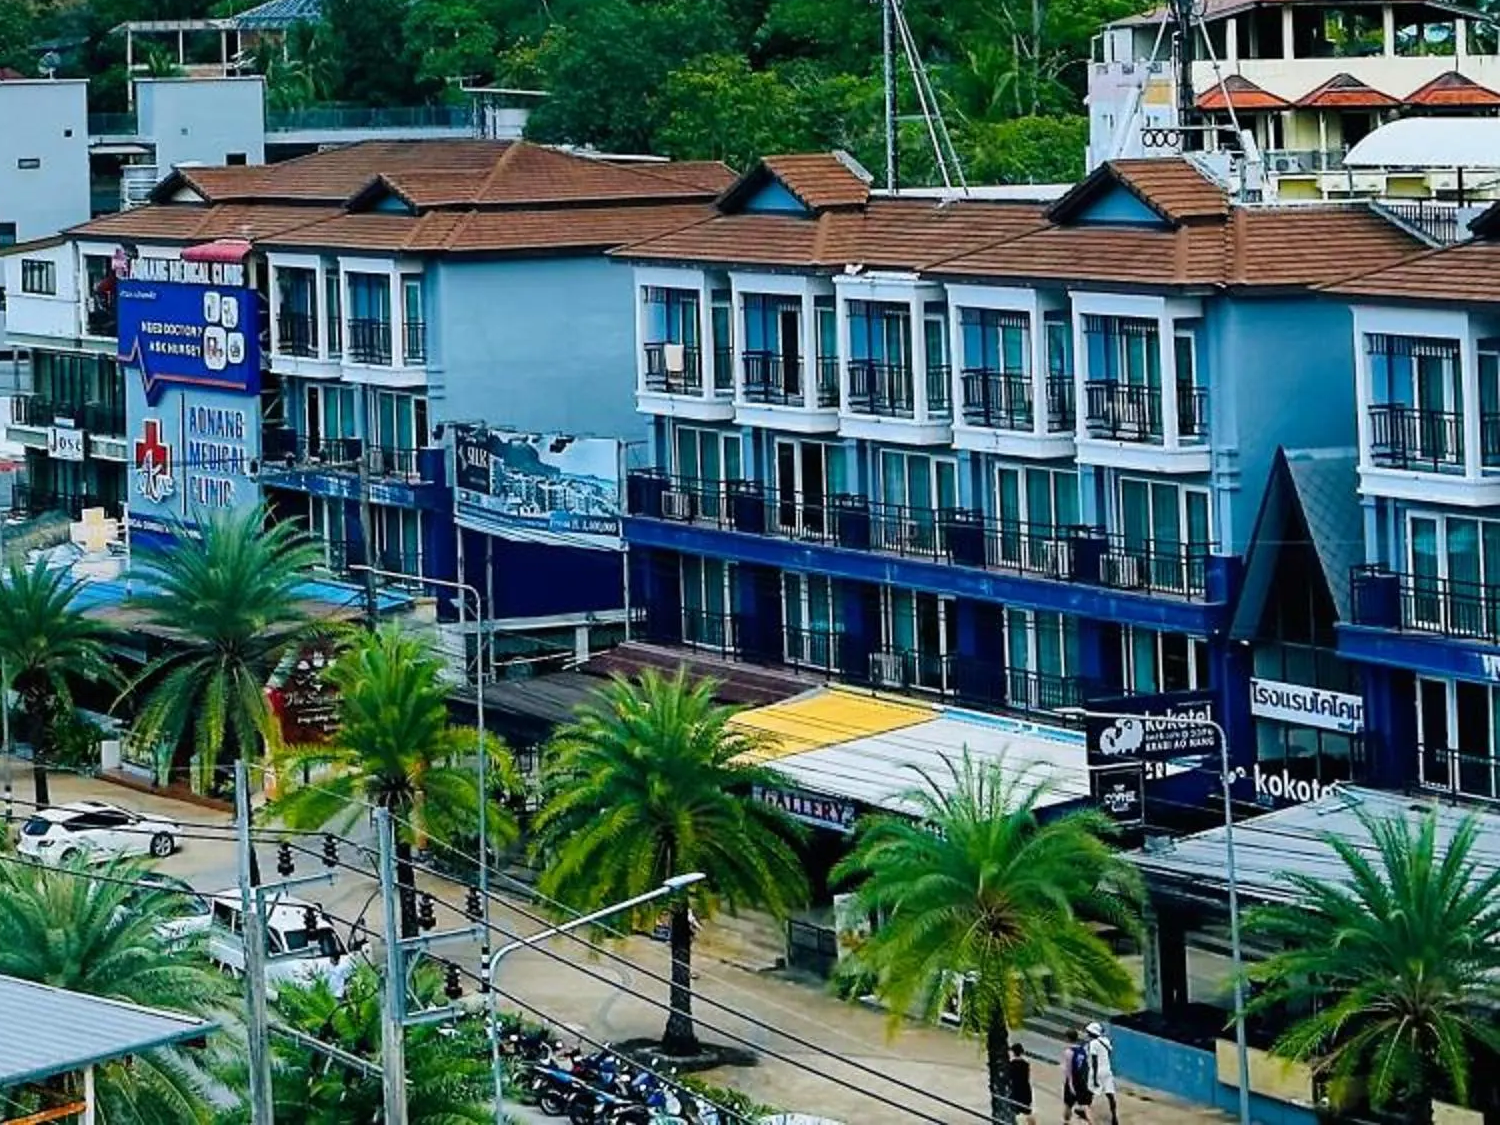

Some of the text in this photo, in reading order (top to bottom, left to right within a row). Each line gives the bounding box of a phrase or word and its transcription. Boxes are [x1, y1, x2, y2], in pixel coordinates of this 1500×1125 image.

[189, 407, 244, 439] AONANG
[189, 441, 246, 475] MEDICAL
[189, 476, 233, 507] CLINIC
[1145, 705, 1211, 732] kokotel
[1145, 741, 1172, 752] KRABI
[1190, 737, 1215, 748] NANG
[765, 789, 842, 822] GALLERY
